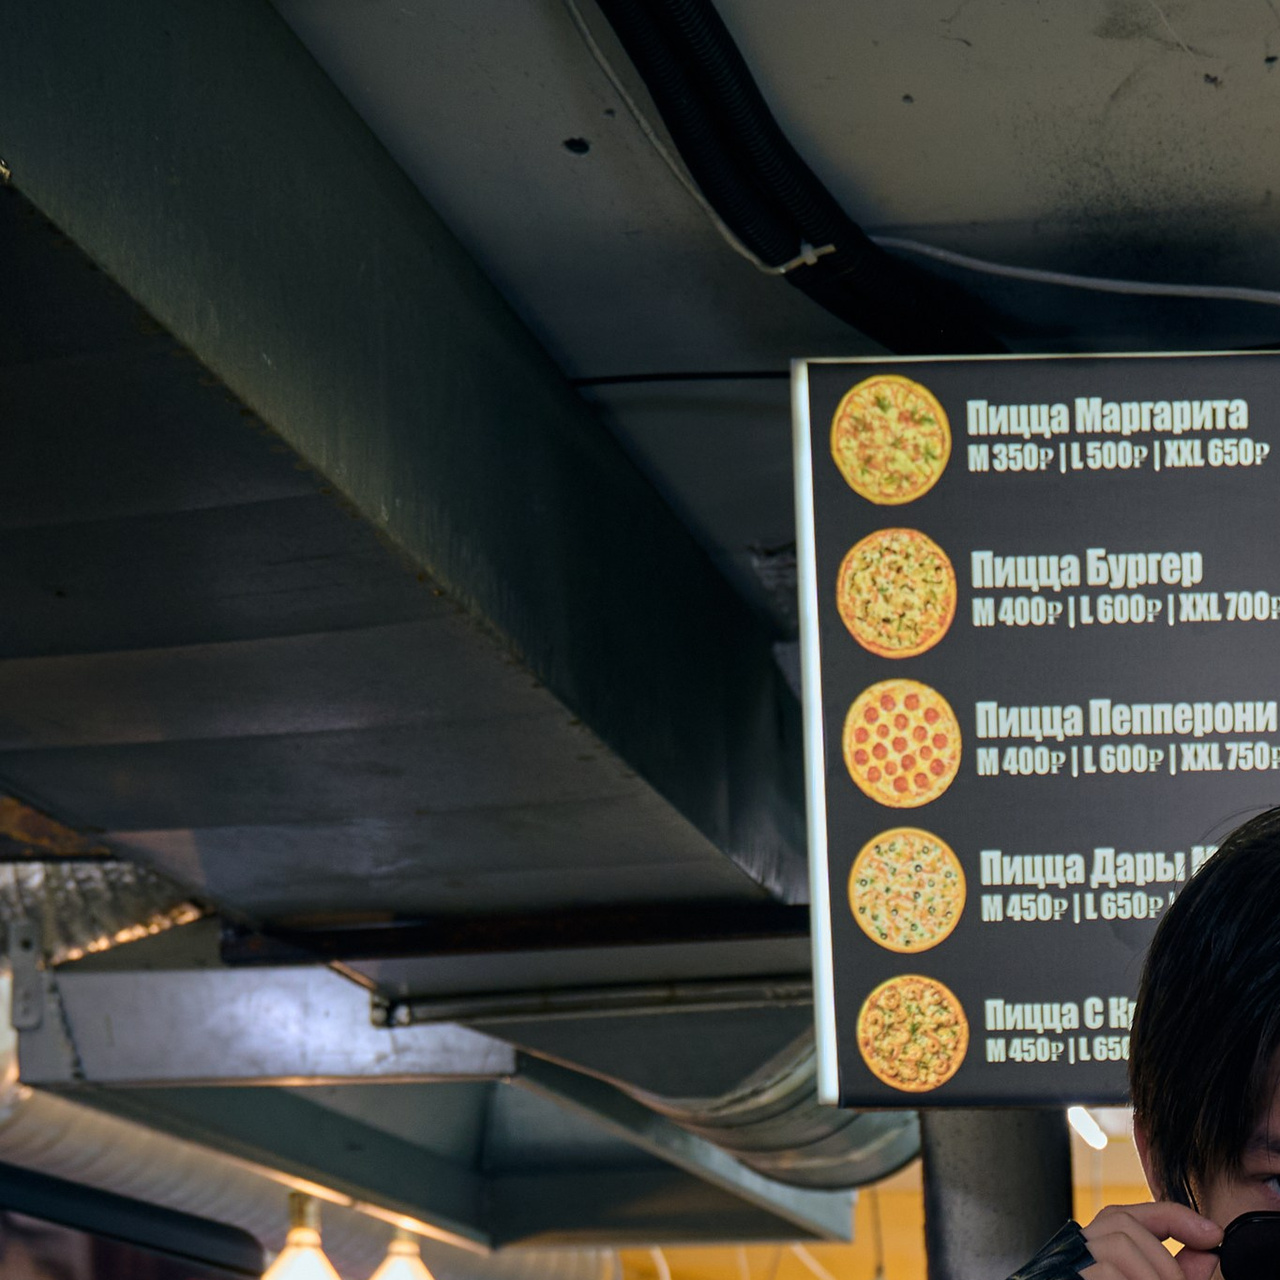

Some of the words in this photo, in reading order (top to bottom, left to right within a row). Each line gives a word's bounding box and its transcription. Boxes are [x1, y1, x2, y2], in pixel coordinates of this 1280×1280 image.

[966, 399, 1070, 440] Пицца
[1074, 397, 1249, 436] Маргарита
[967, 444, 990, 472] M
[1070, 441, 1084, 470] L
[1163, 439, 1206, 468] XXL
[971, 550, 1081, 593] Пицца
[1086, 548, 1203, 589] Бургер
[975, 701, 1084, 743] Пицца
[1089, 698, 1278, 738] Пепперони
[980, 850, 1085, 890] Пицца
[1089, 847, 1186, 889] Дары
[984, 998, 1080, 1034] Пицца
